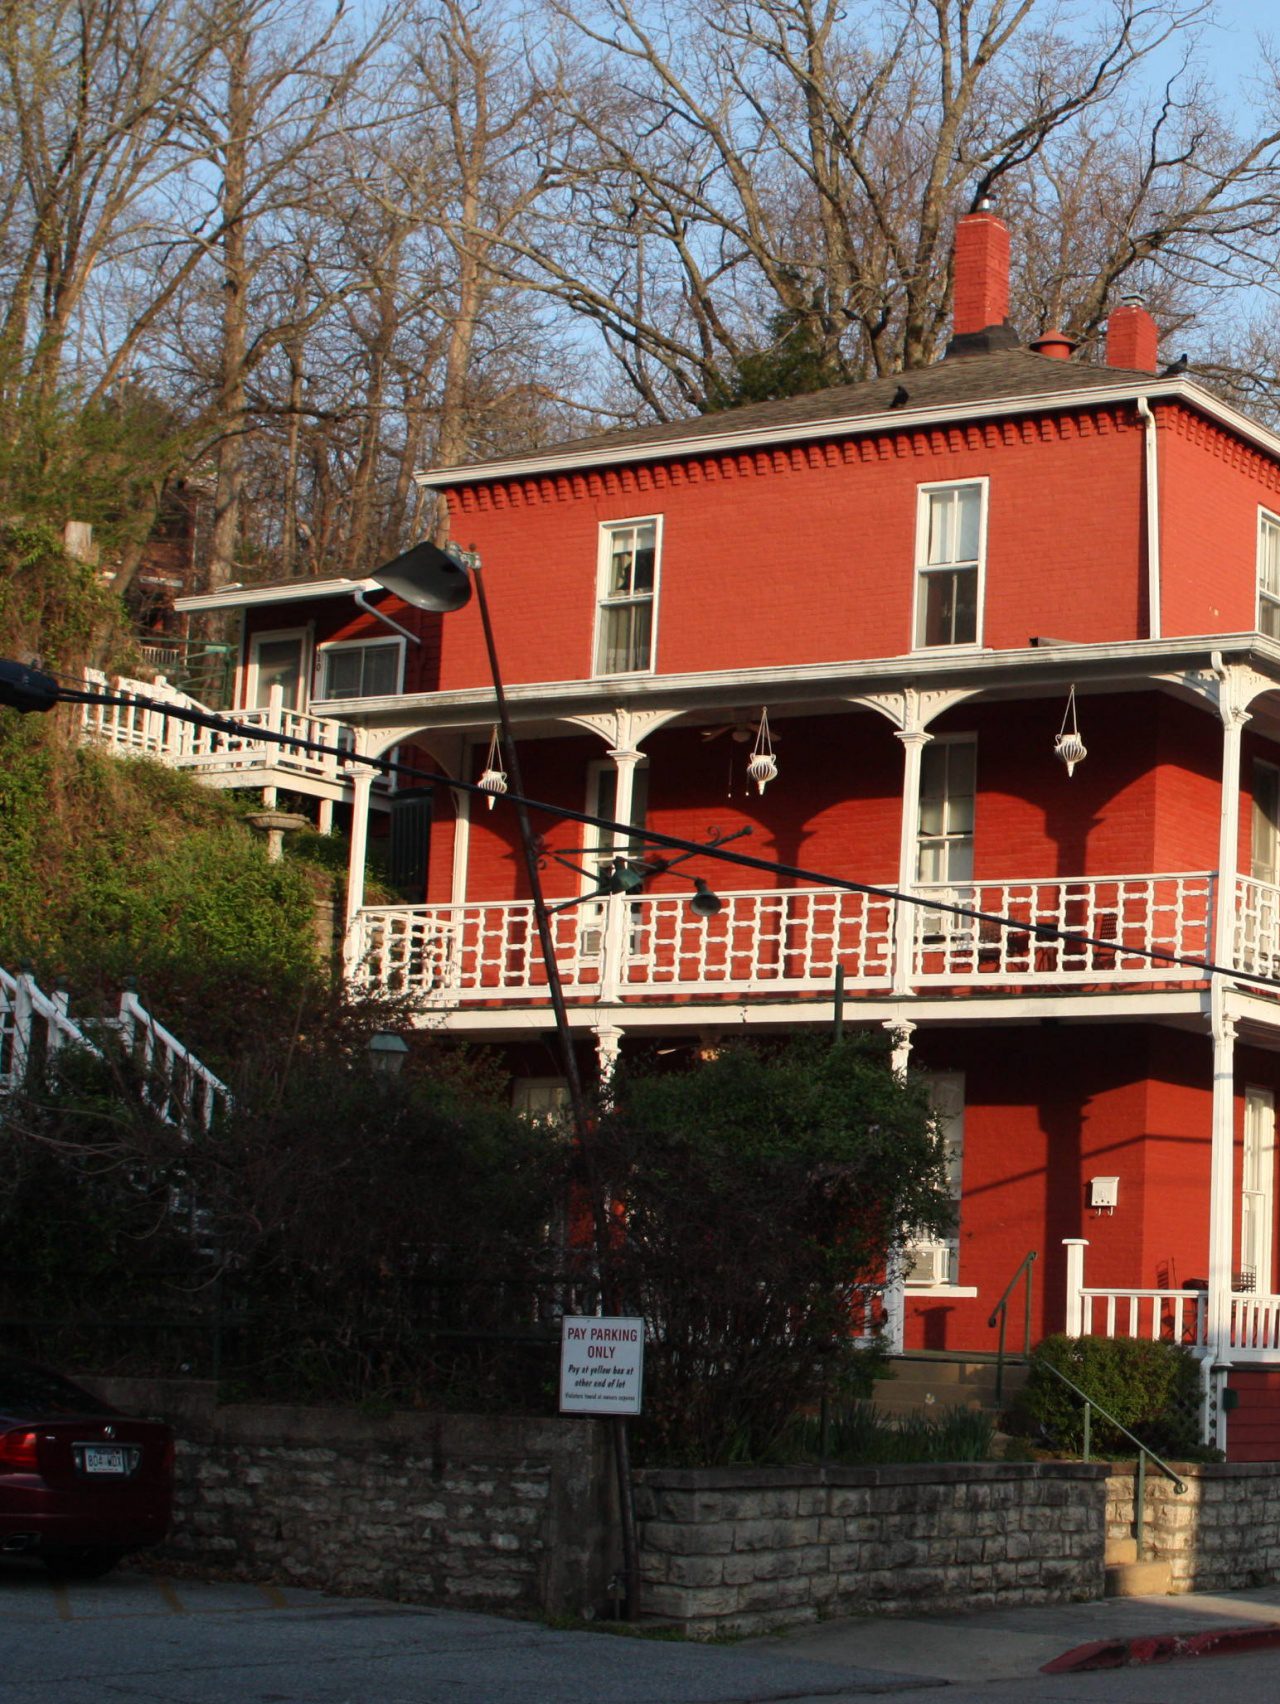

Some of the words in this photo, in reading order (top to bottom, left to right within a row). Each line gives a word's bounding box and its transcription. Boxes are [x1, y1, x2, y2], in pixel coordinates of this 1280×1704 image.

[567, 1327, 587, 1340] PAY
[590, 1328, 638, 1342] PARKING
[587, 1345, 616, 1359] ONLY
[568, 1364, 579, 1375] Pay
[582, 1366, 589, 1374] at
[590, 1365, 611, 1376] yellow
[613, 1366, 624, 1375] box
[626, 1367, 634, 1375] at
[575, 1379, 592, 1387] other
[594, 1379, 605, 1388] end
[607, 1379, 615, 1388] of
[616, 1380, 626, 1389] lot
